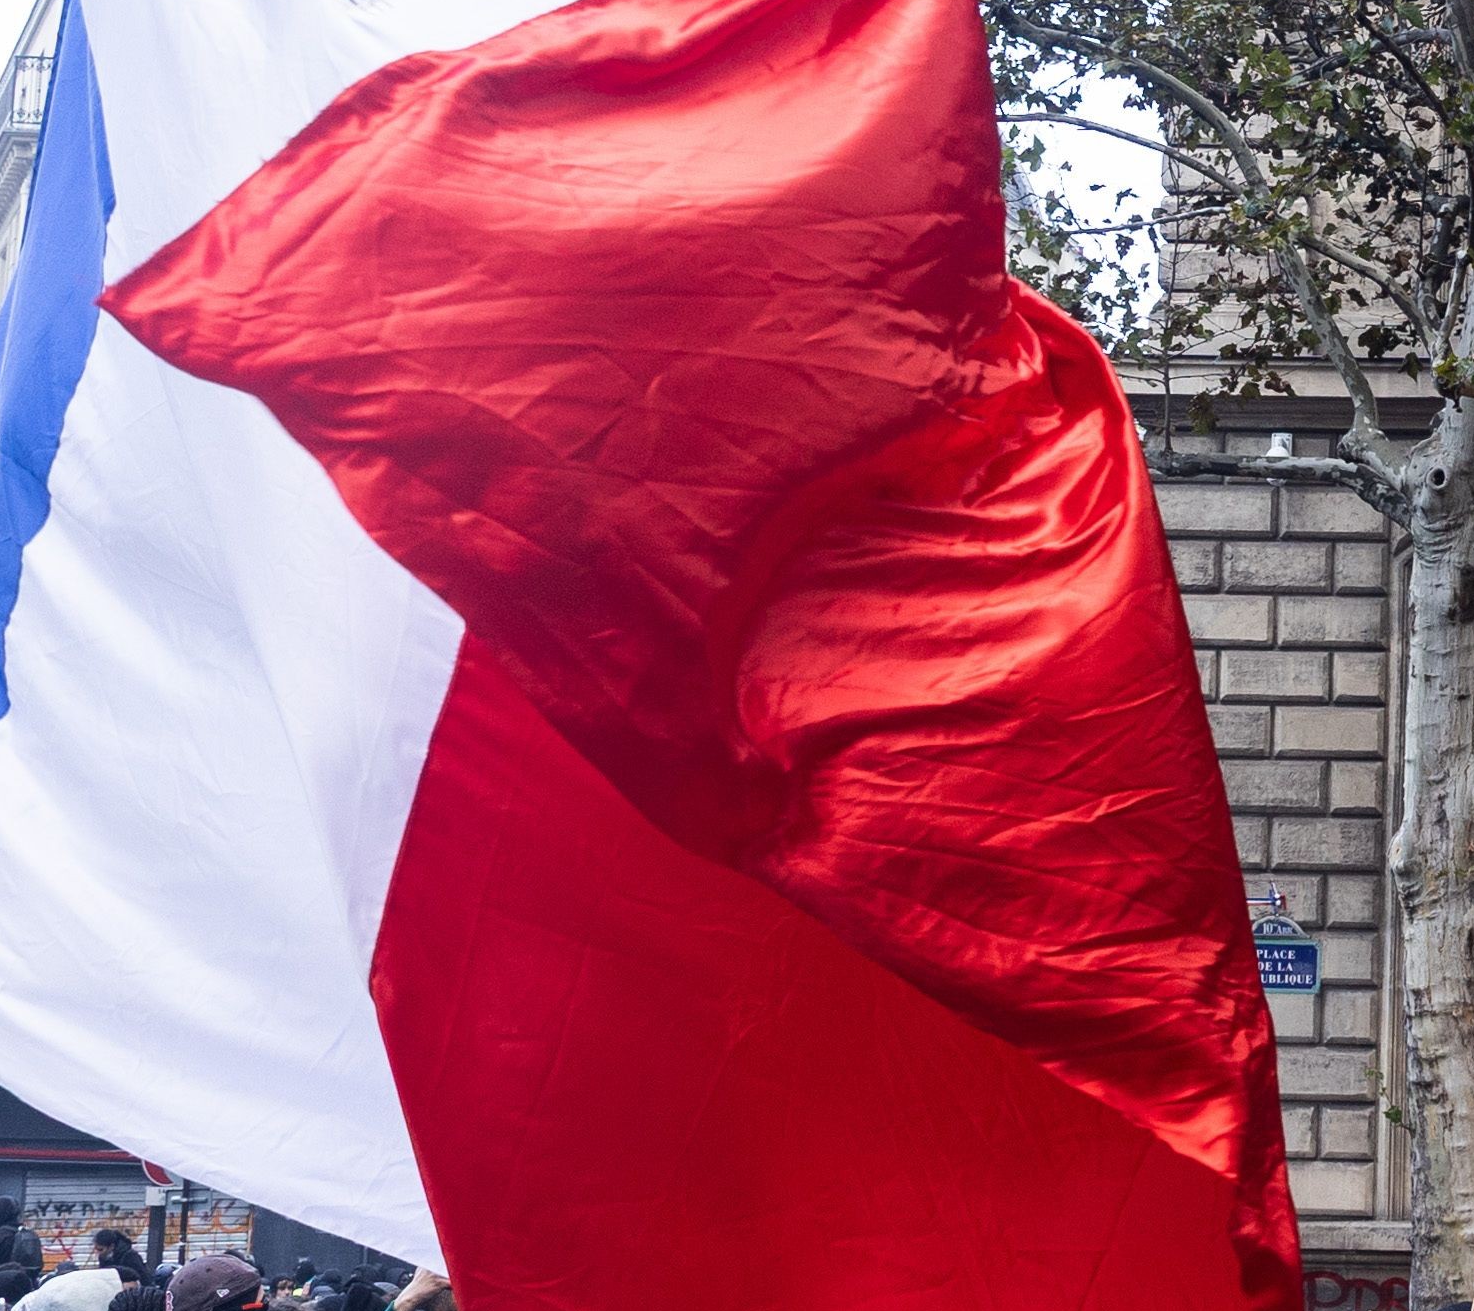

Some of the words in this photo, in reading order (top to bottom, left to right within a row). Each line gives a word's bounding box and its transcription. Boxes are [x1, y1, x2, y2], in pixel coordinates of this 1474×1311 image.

[1256, 949, 1296, 960] PLACE
[1277, 961, 1293, 972] LA
[1260, 974, 1313, 985] UBLIQUE
